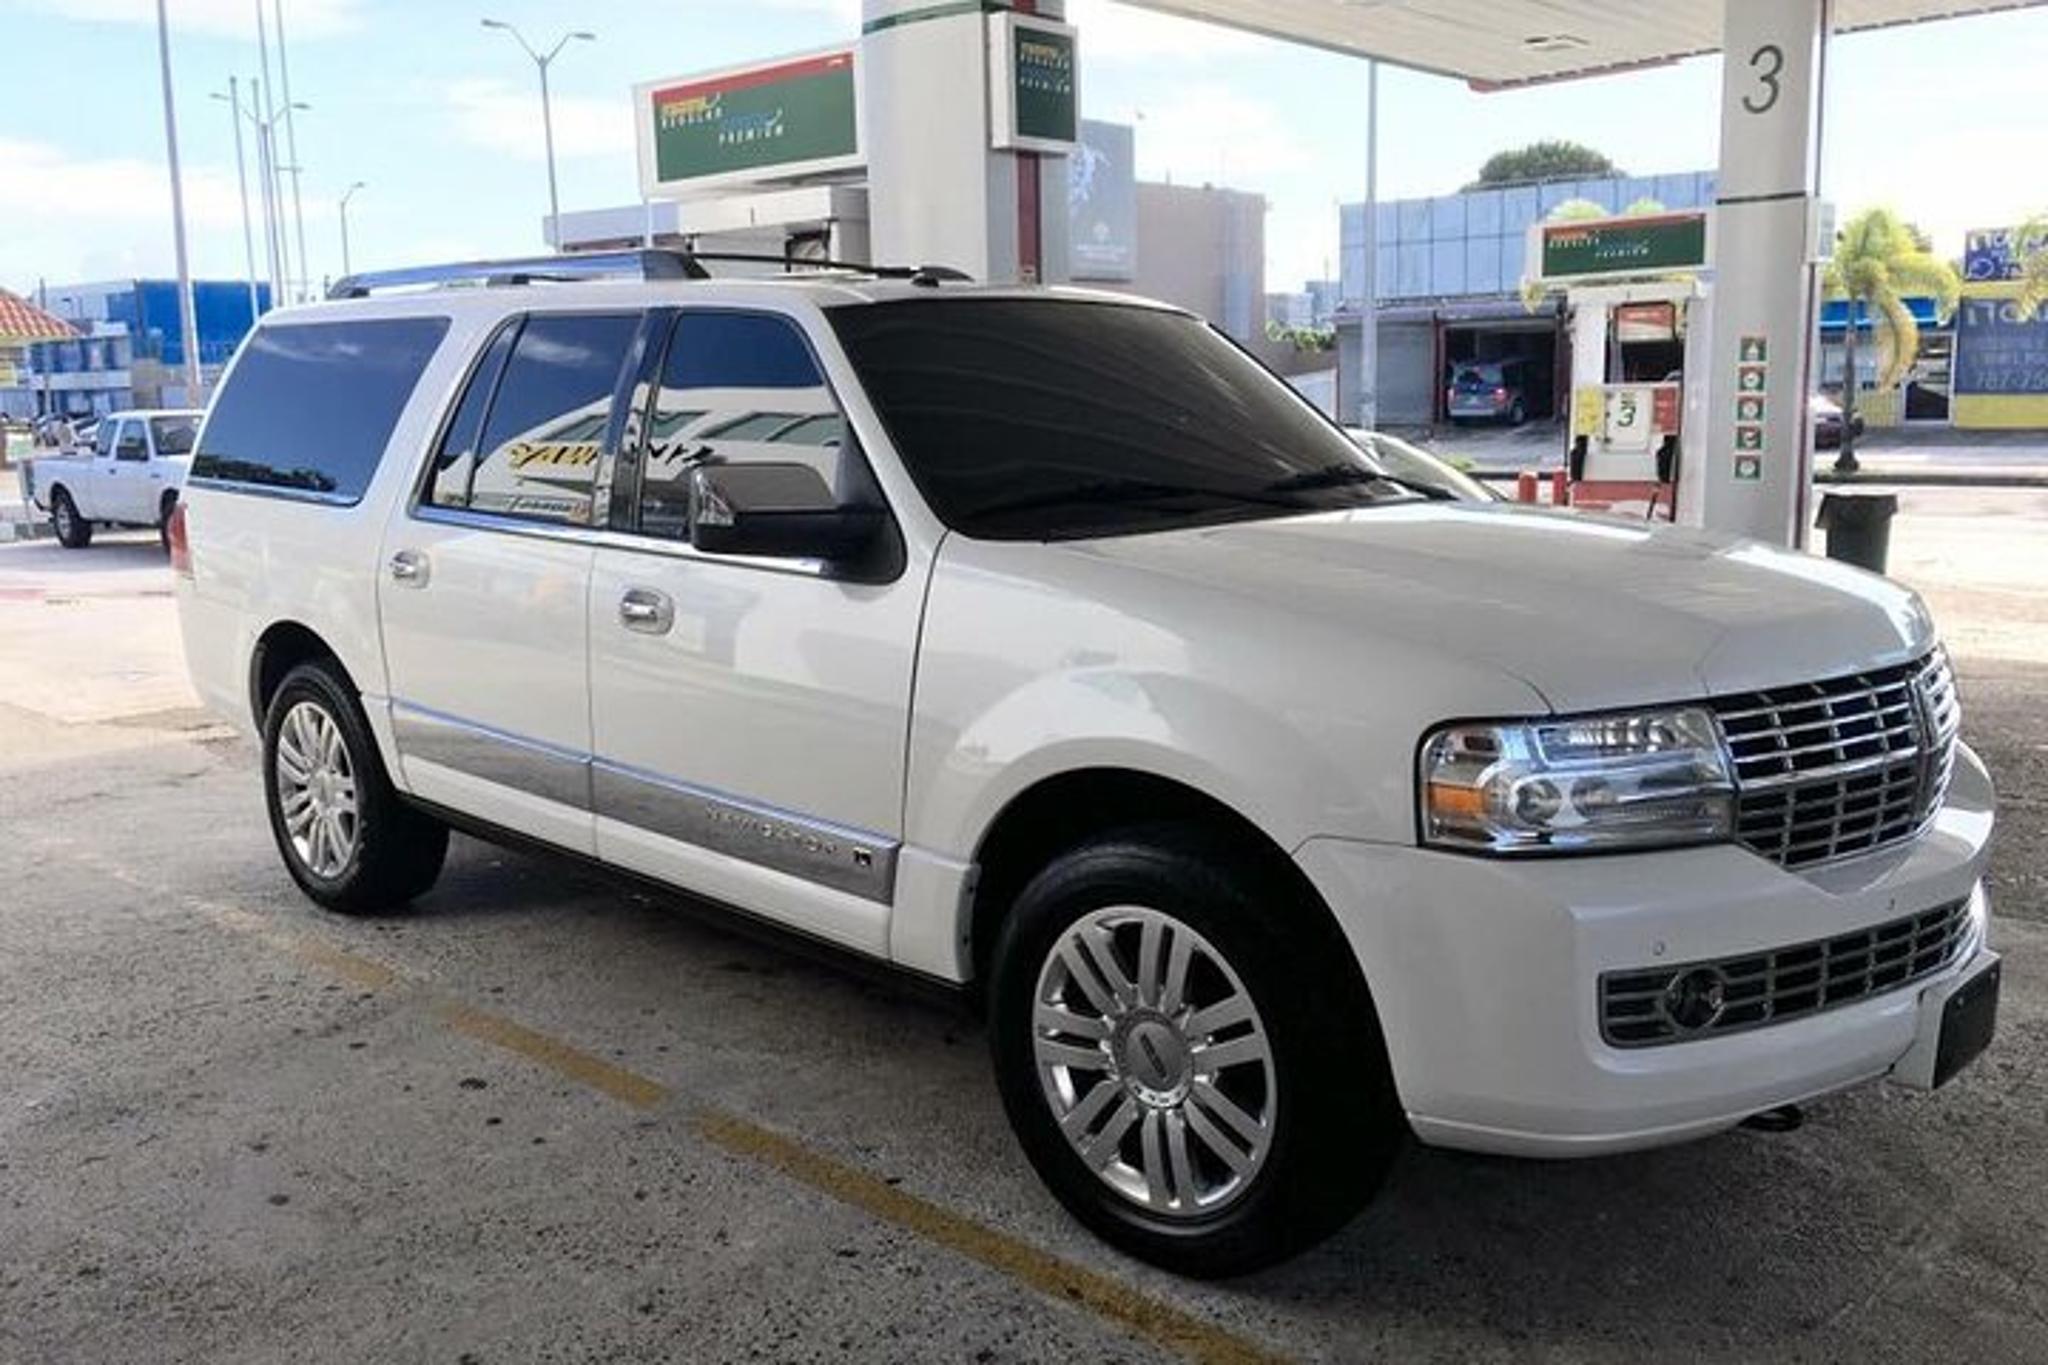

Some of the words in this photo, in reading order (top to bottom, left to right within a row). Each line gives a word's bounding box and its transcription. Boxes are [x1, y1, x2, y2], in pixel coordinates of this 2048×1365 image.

[1742, 44, 1784, 114] 3
[719, 123, 783, 145] PREMIUM
[1617, 403, 1637, 428] 3
